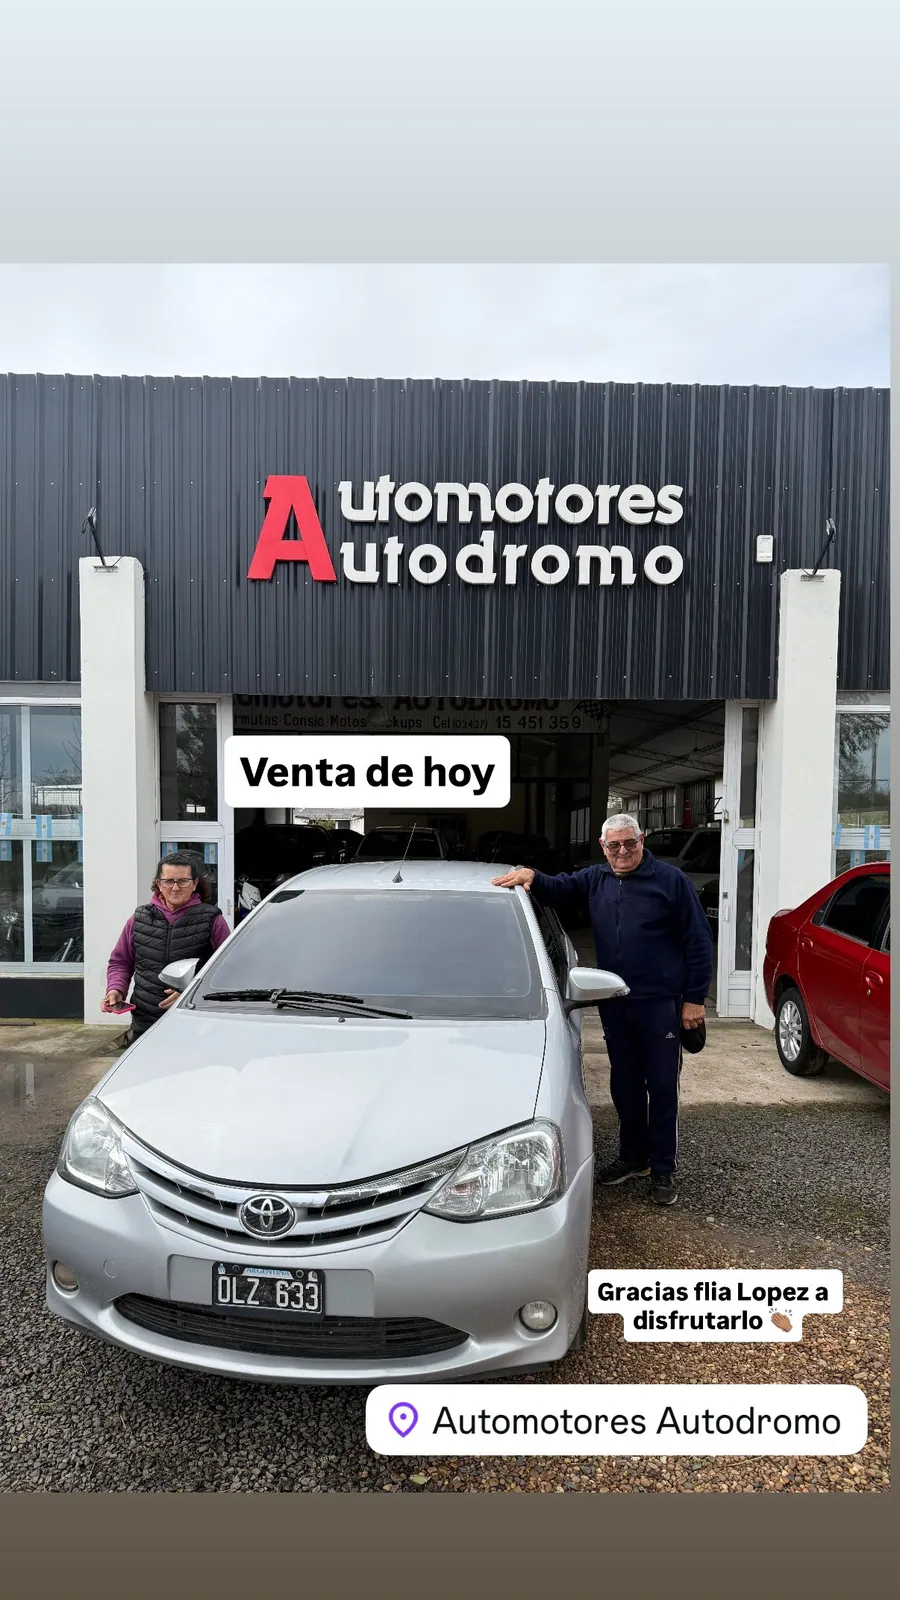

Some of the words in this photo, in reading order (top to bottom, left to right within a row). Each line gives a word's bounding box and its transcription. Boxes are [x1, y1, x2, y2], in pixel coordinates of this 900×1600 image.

[331, 714, 367, 728] Motos
[433, 715, 450, 729] Cel
[496, 715, 511, 729] 15
[517, 715, 544, 729] 451
[549, 715, 581, 730] 359
[218, 1276, 260, 1305] OLZ
[276, 1280, 319, 1310] 633
